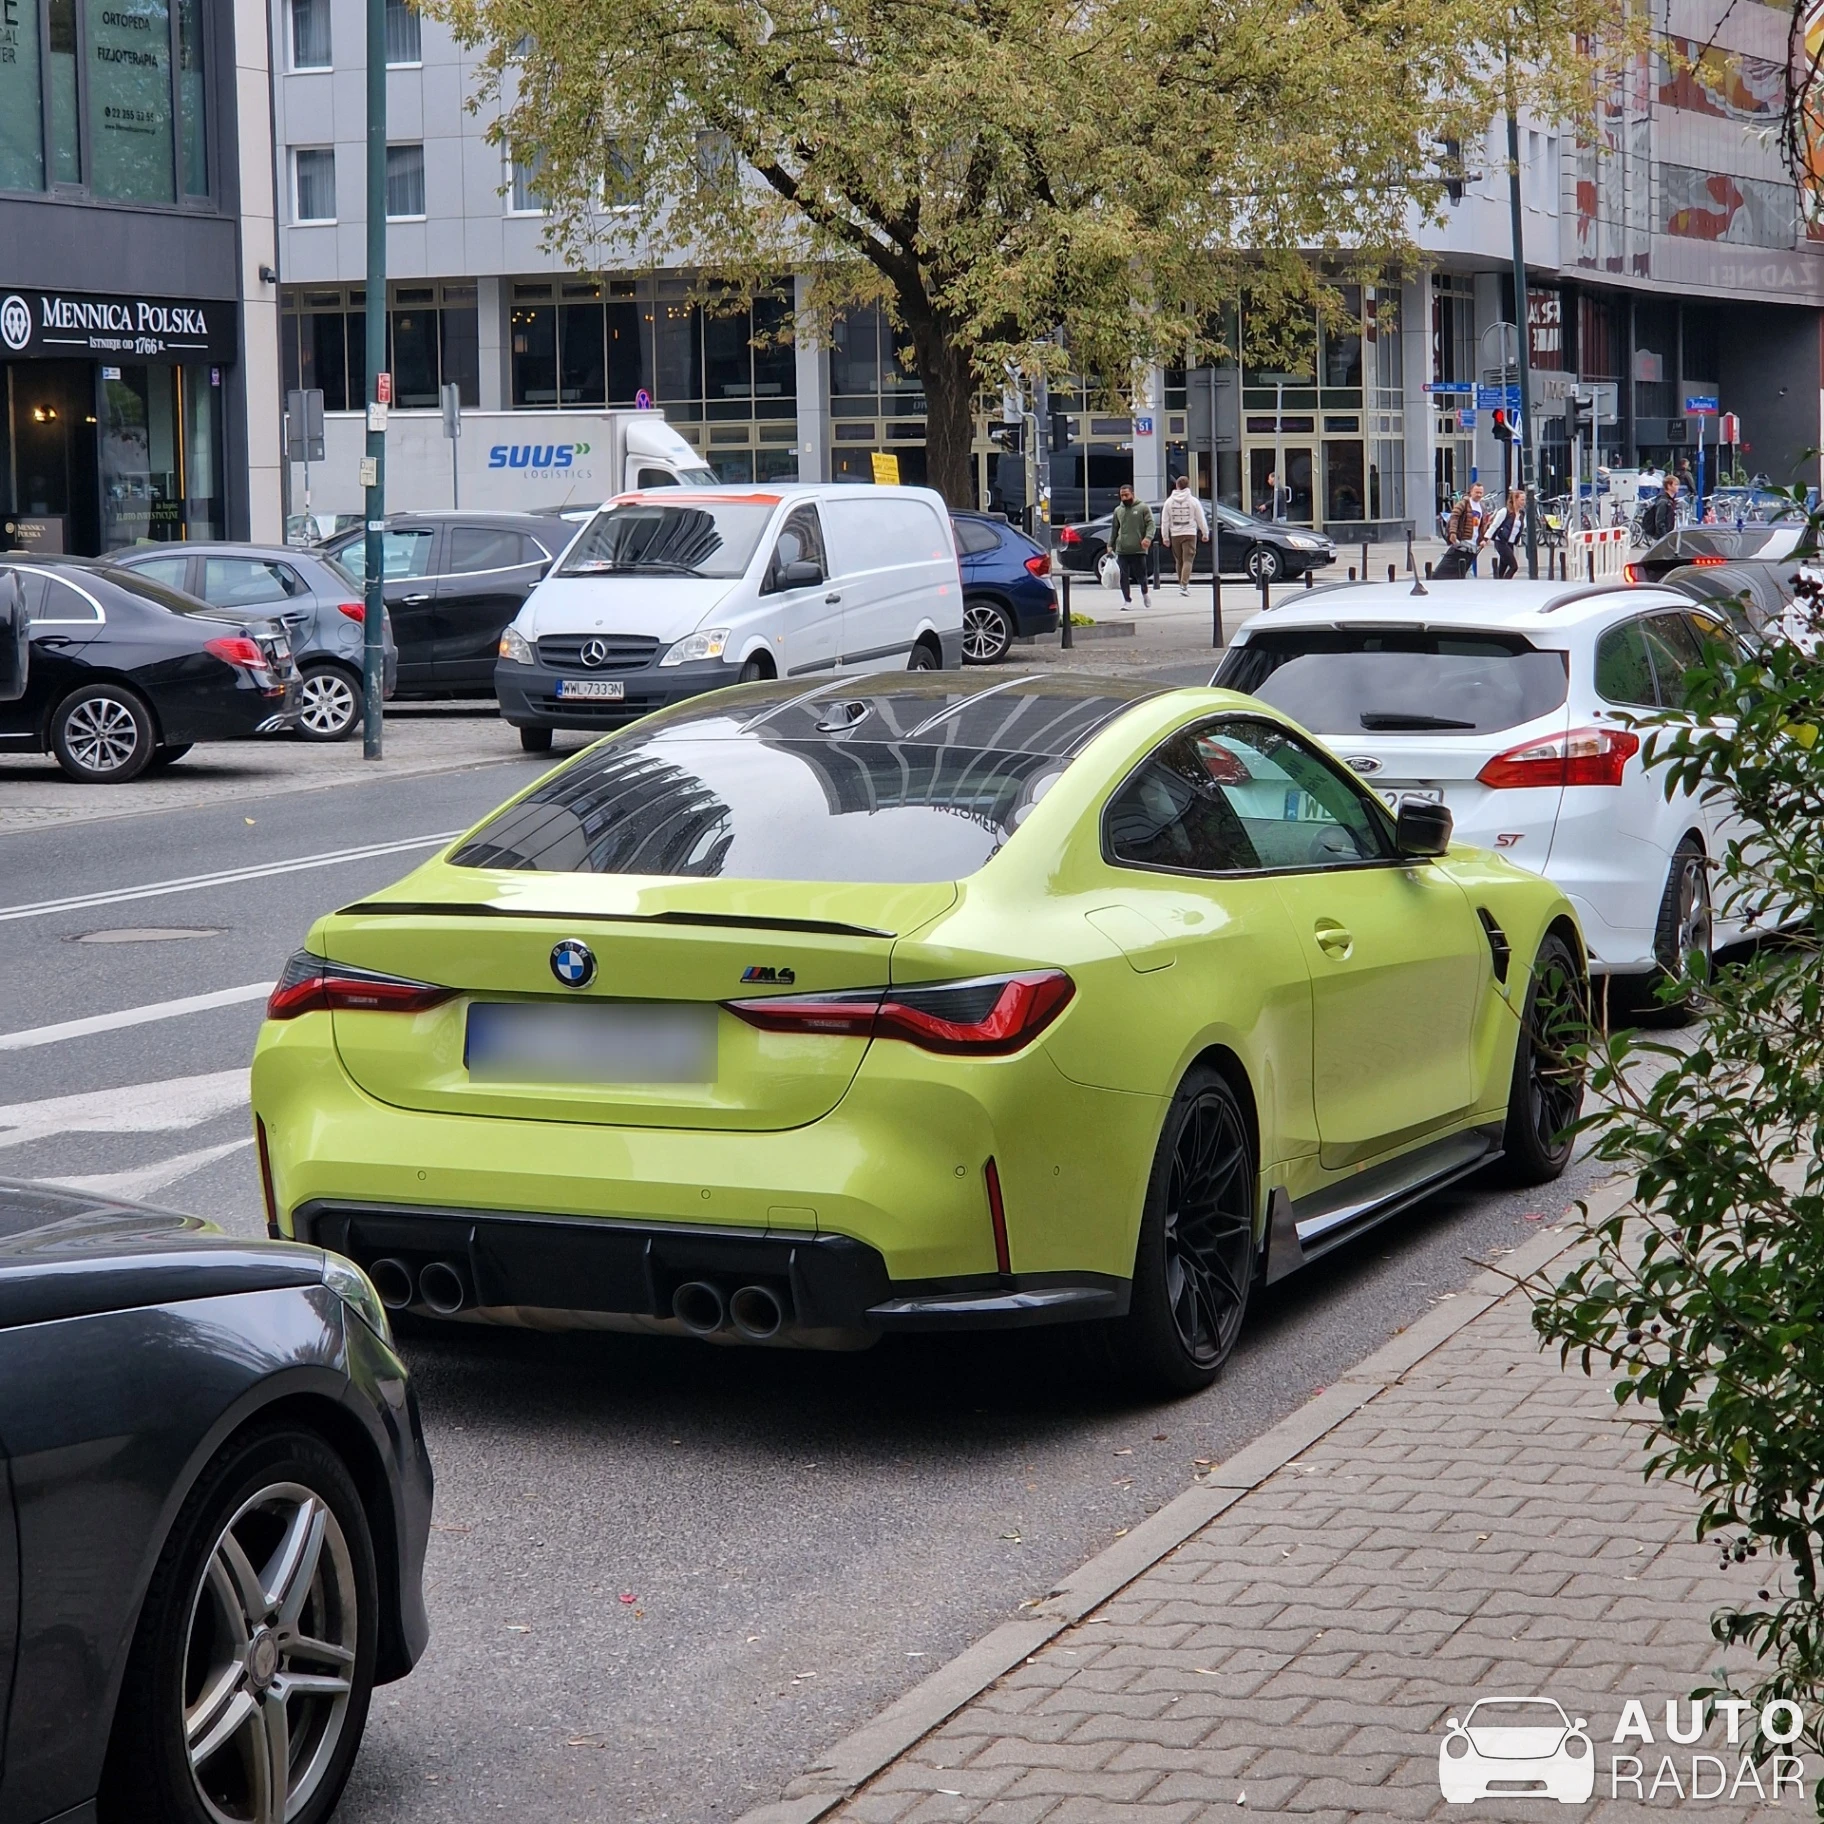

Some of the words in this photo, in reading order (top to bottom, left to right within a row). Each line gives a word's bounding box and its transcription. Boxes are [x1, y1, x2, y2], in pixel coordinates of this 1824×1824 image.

[102, 11, 151, 31] ORTOPEDA
[97, 46, 159, 68] FIZJOTERAPIA
[41, 297, 134, 332] MENNICA
[136, 302, 208, 334] POLSKA
[89, 335, 122, 351] ISTNIEJE
[122, 341, 134, 350] OD
[135, 337, 157, 355] 1766
[488, 444, 574, 468] SUUS
[523, 469, 592, 479] LOGISTICS
[563, 682, 583, 696] WWL
[587, 682, 622, 696] 7333N
[1350, 759, 1372, 772] Ford
[1493, 833, 1526, 848] ST
[552, 942, 589, 959] BMW
[750, 966, 795, 982] M4
